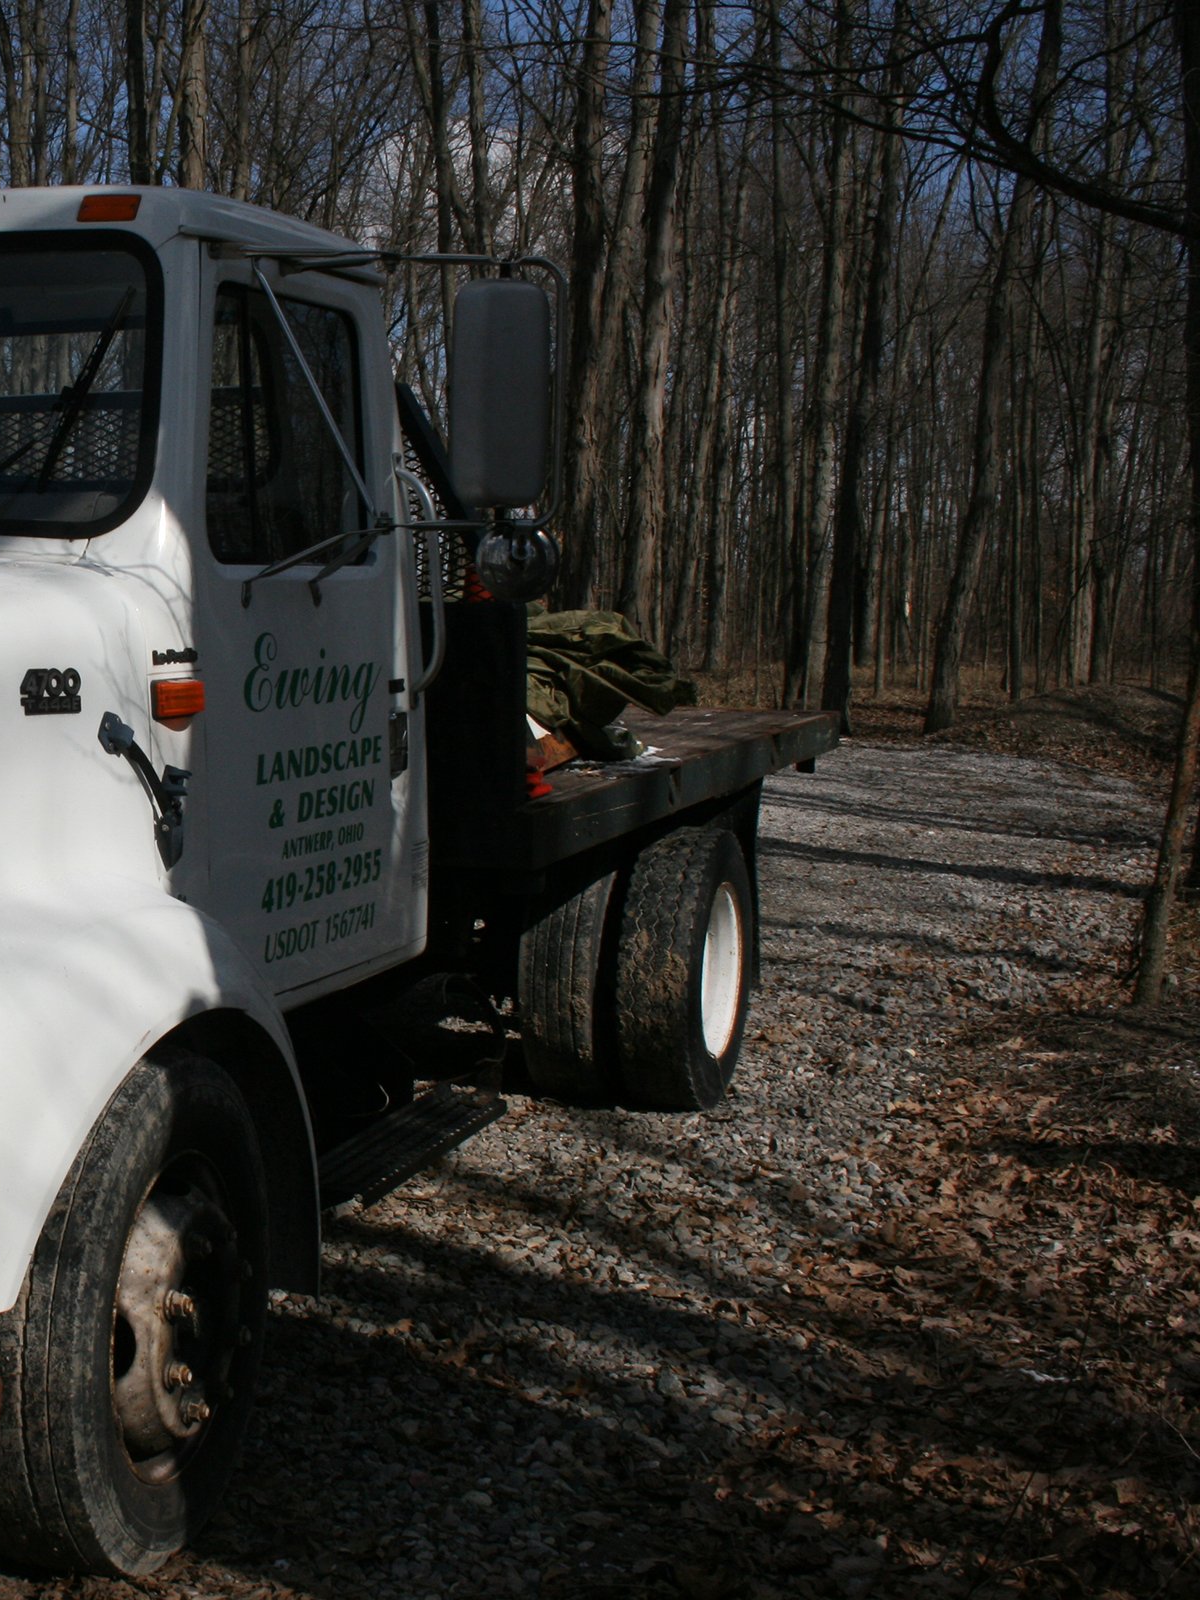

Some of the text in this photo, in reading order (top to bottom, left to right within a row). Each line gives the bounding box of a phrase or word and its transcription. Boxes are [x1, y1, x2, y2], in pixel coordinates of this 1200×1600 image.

[20, 668, 82, 698] 4700
[244, 632, 382, 734] Ewing
[256, 735, 382, 786] LANDSCAPE
[268, 778, 375, 829] & DESIGN
[282, 822, 364, 859] ANTWERP, OHIO
[261, 848, 382, 914] 419-258-2955
[264, 902, 375, 963] USDOT 1567741
